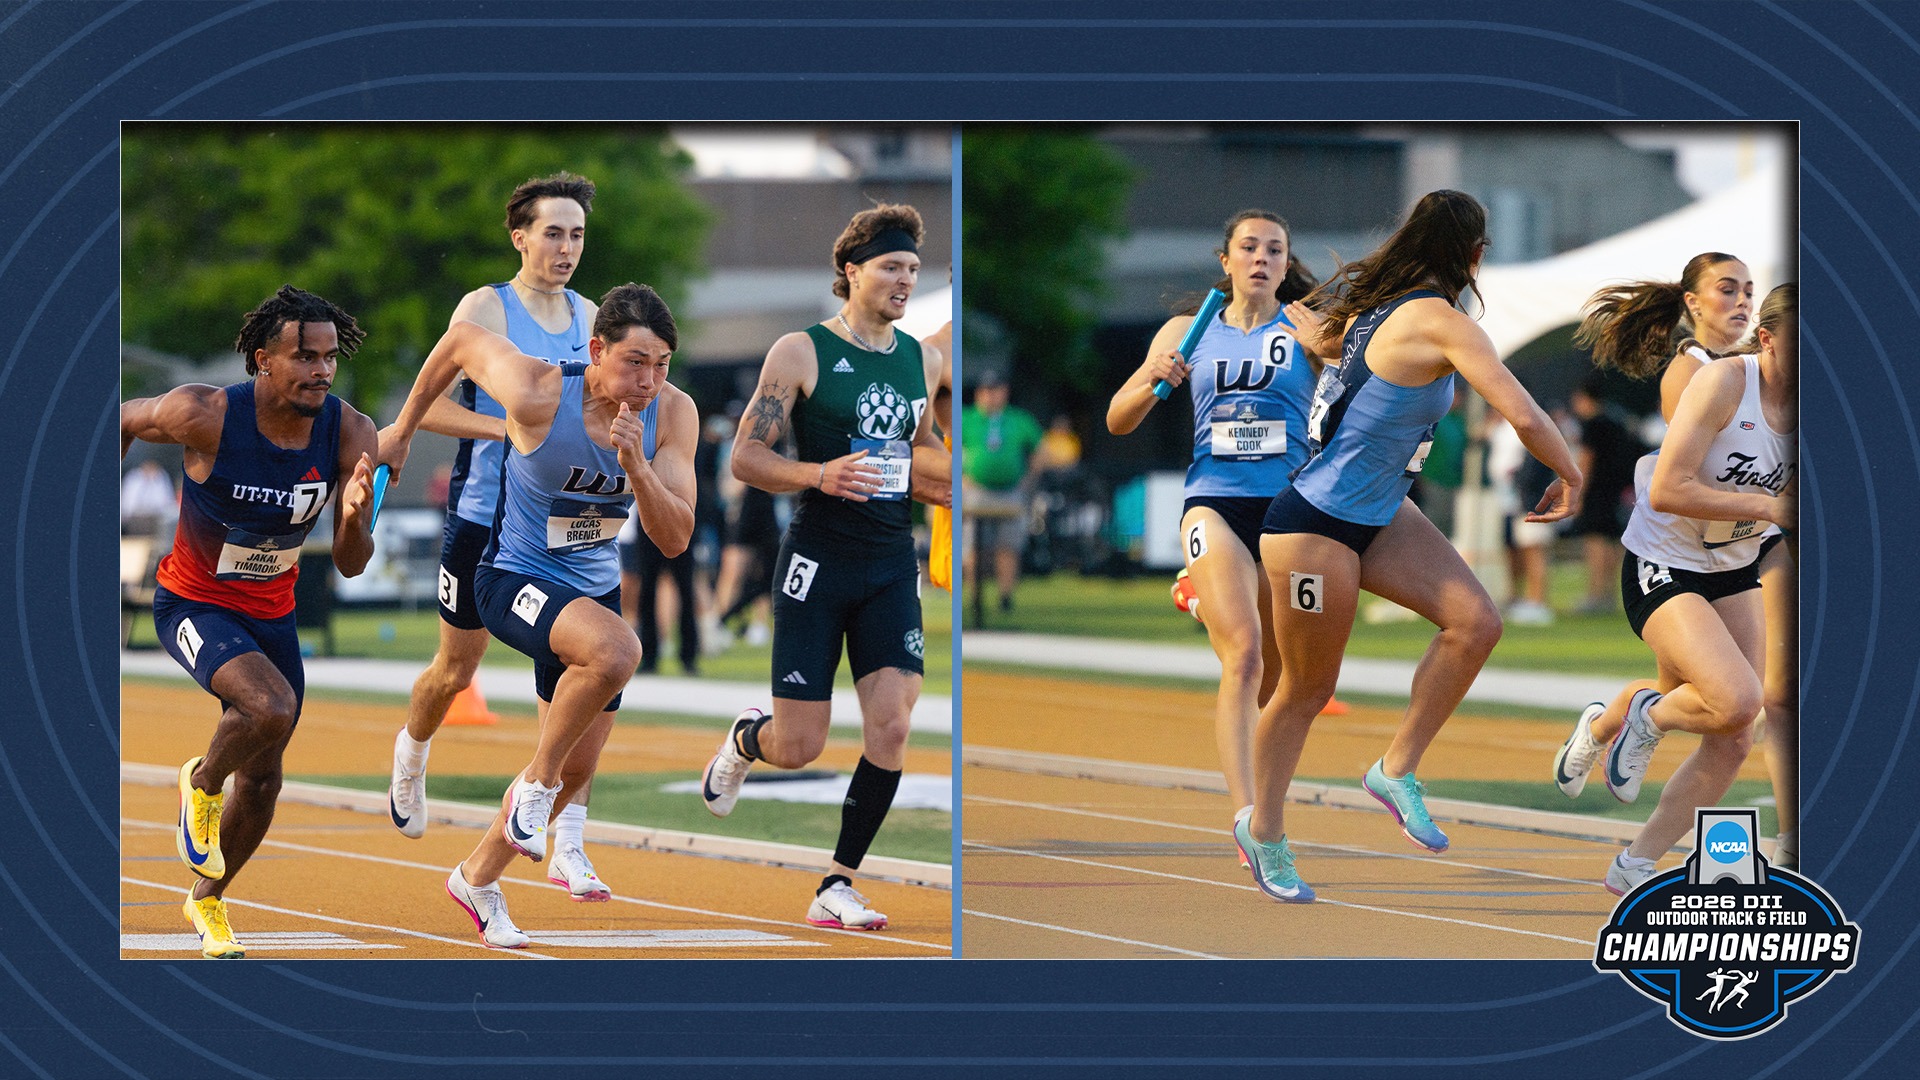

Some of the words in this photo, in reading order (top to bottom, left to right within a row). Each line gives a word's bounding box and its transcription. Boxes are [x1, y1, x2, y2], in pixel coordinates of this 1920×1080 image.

[1269, 335, 1287, 366] 6
[869, 414, 893, 435] N
[1228, 426, 1269, 439] KENNEDY
[1236, 440, 1262, 452] COOK
[301, 488, 319, 522] 7
[566, 529, 602, 542] BRENEK
[570, 519, 602, 529] LUCAS
[1730, 526, 1754, 539] ELLIS
[1189, 526, 1201, 559] 6
[234, 560, 282, 574] TIMMONS
[246, 553, 279, 564] JAKAI
[789, 562, 809, 596] 6
[1643, 560, 1665, 591] 2
[441, 572, 451, 605] 3
[1297, 577, 1316, 611] 6
[517, 591, 541, 619] 3
